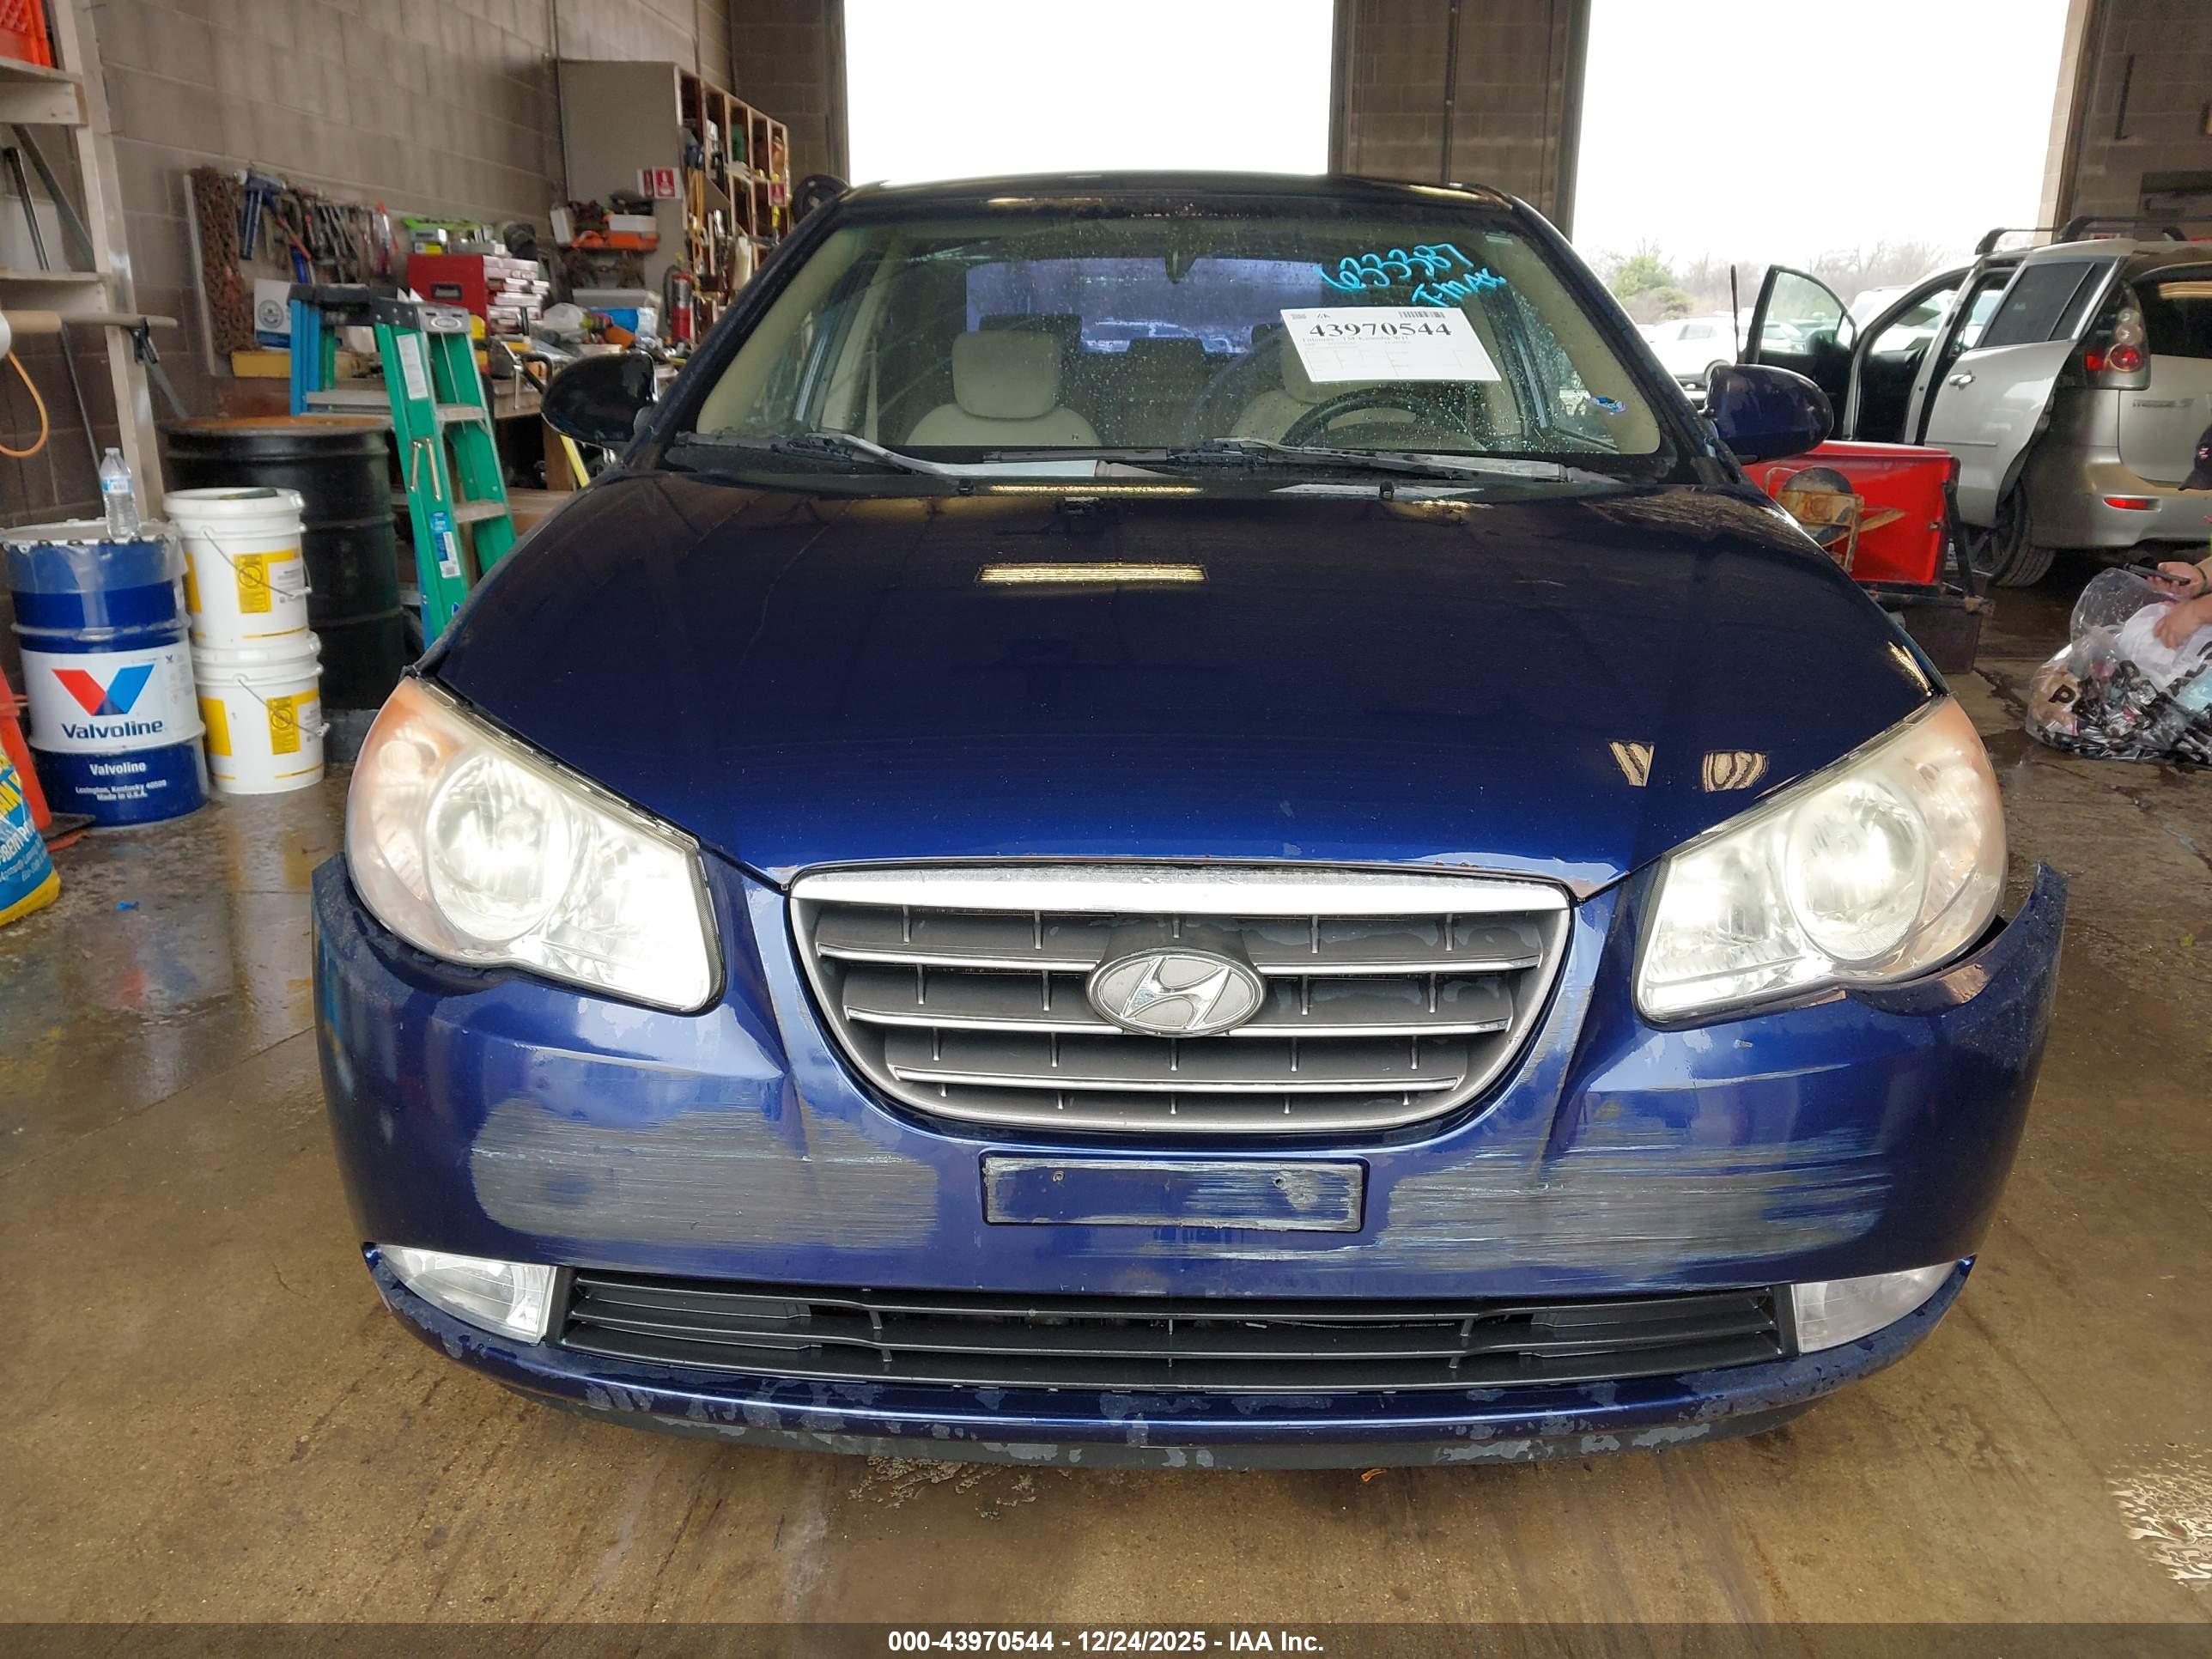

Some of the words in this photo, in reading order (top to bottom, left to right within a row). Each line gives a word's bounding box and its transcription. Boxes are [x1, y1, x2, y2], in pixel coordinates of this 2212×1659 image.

[1310, 322, 1453, 337] 43970544
[61, 720, 163, 739] Valvoline
[88, 761, 147, 775] Valvoline
